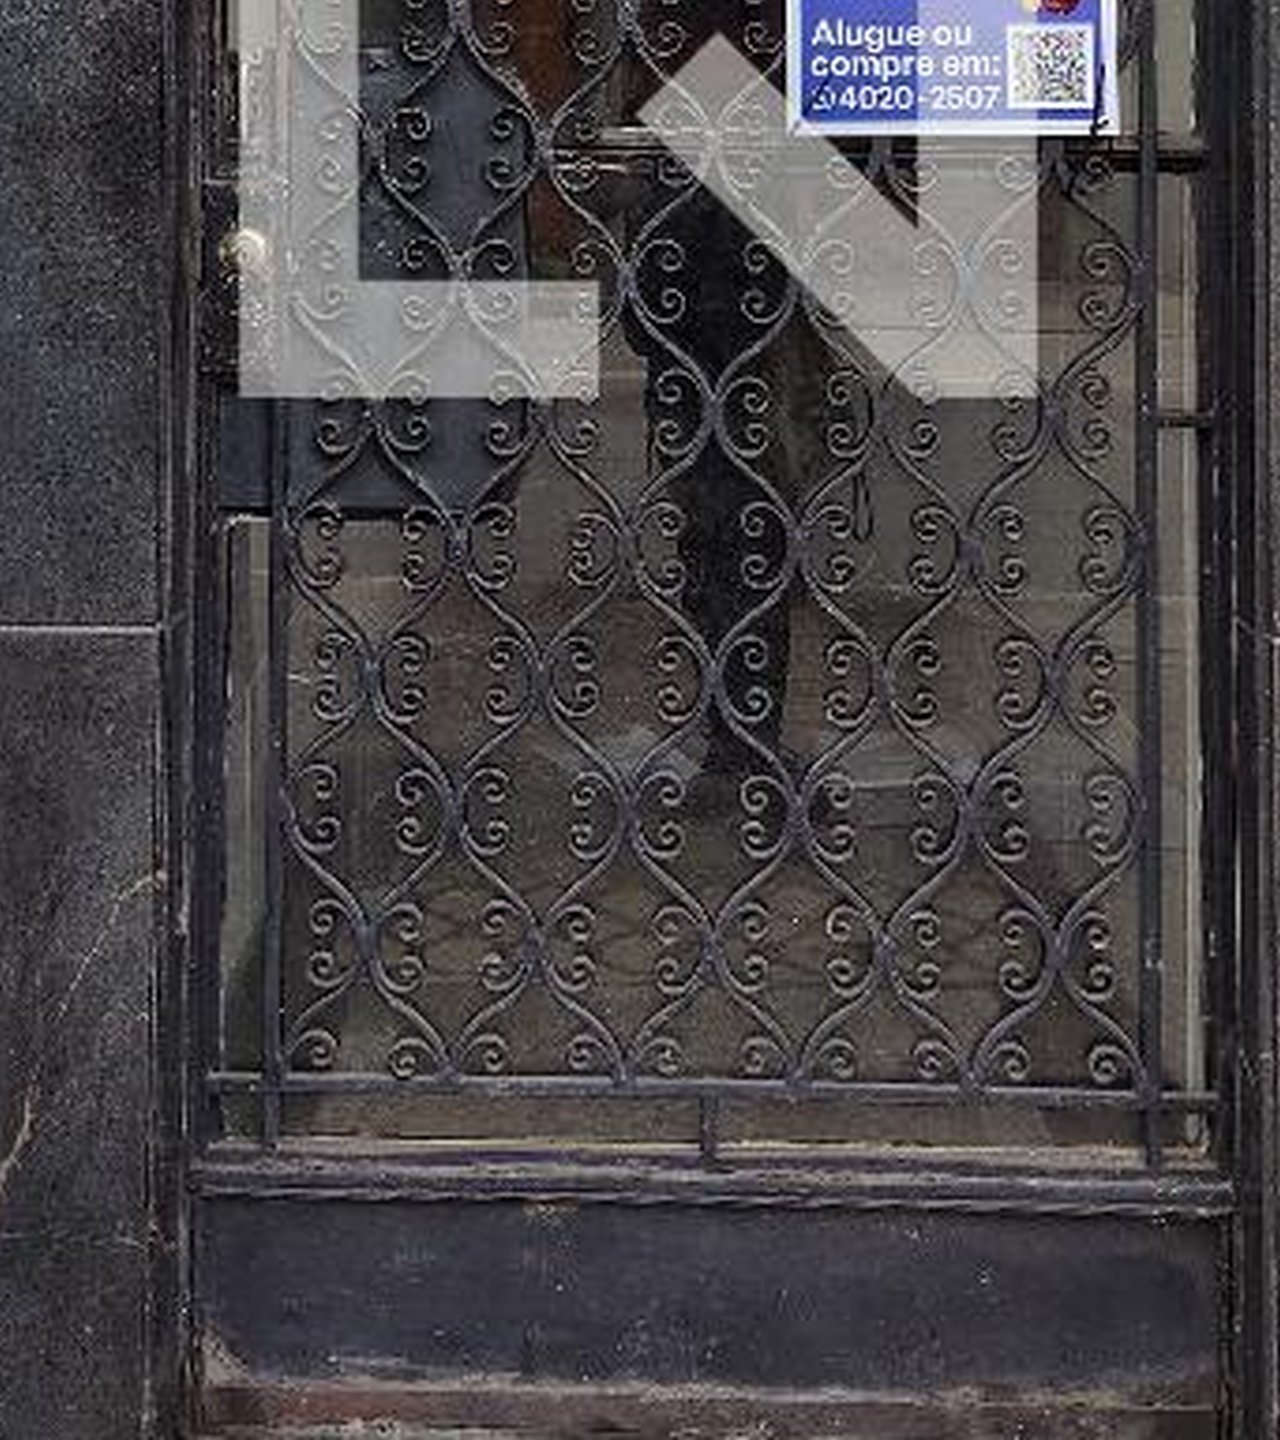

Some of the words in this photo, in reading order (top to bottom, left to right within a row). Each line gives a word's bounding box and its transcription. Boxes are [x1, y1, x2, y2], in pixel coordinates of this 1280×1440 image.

[811, 19, 925, 53] Alugue
[933, 24, 972, 47] ou
[811, 56, 934, 83] compre
[943, 54, 1001, 77] em:
